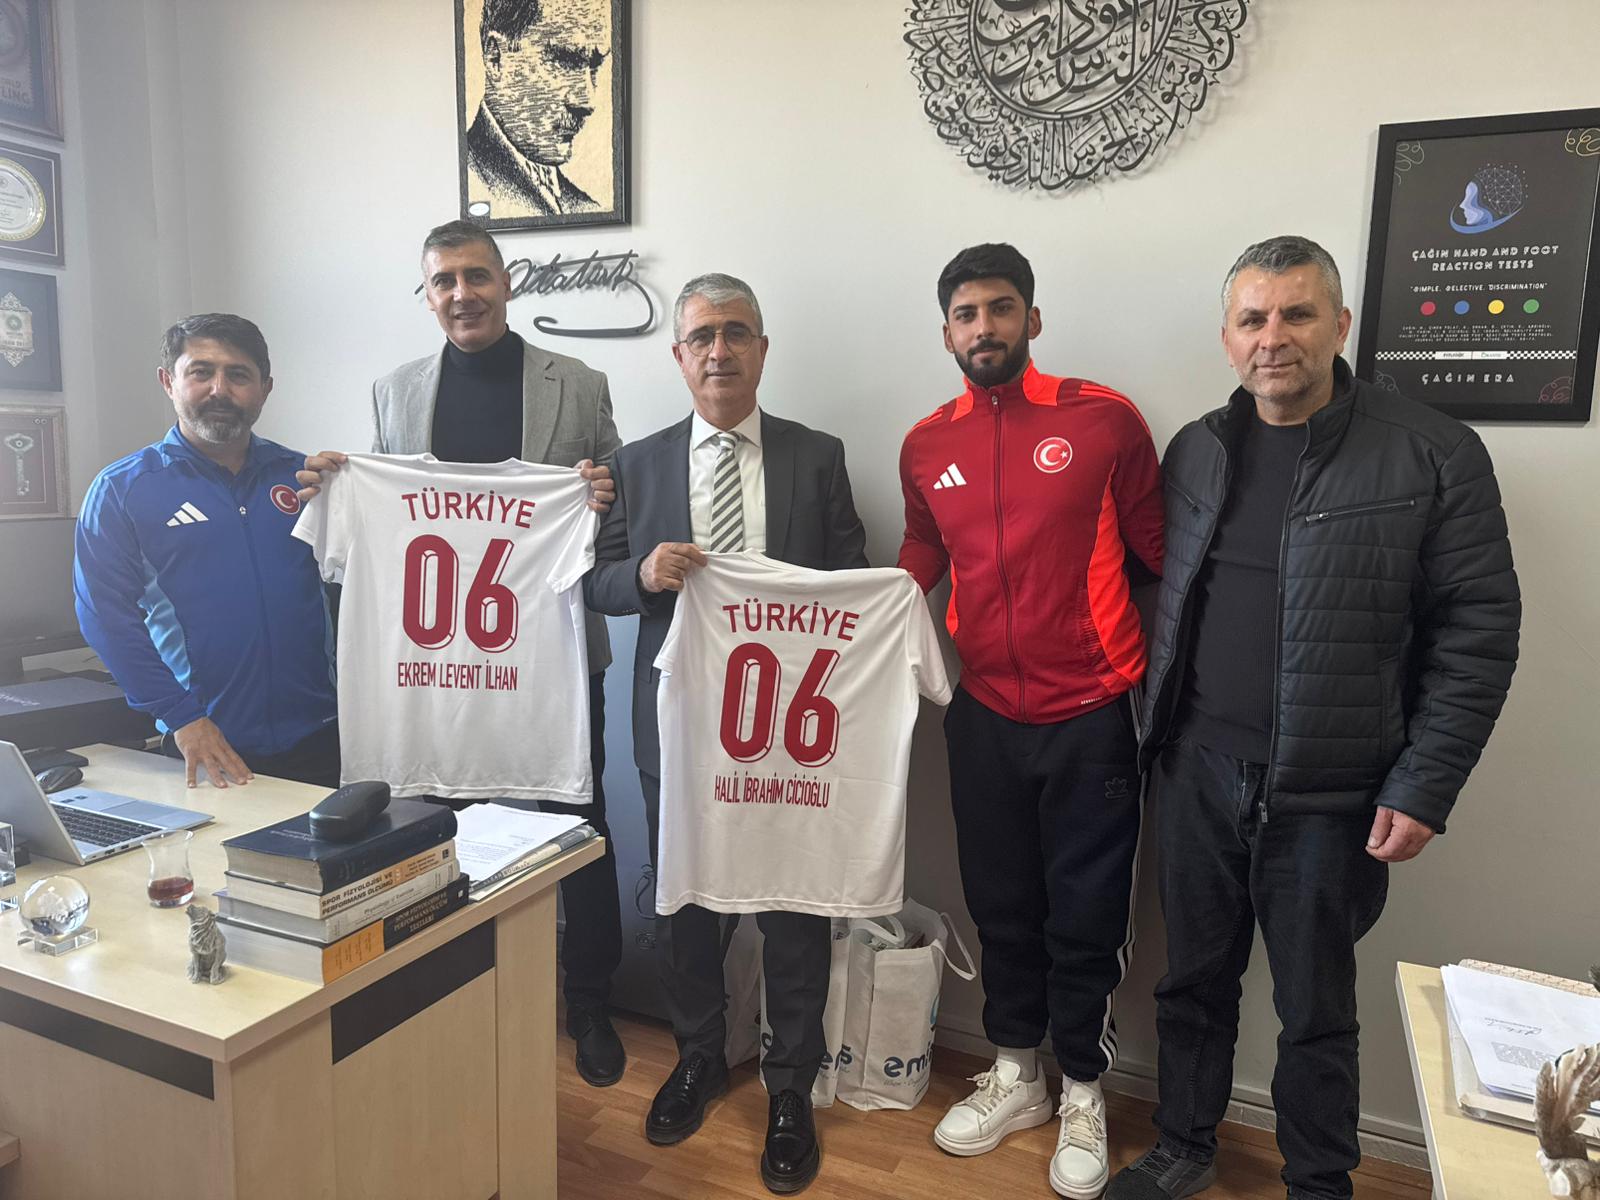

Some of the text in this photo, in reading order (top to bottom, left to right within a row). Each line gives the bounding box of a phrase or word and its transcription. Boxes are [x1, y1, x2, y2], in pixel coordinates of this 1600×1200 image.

[1432, 259, 1534, 272] REACTION TESTS
[1453, 248, 1488, 257] HAND
[1492, 247, 1519, 257] AND
[1523, 245, 1559, 255] FOOT
[1483, 373, 1514, 383] ERA
[401, 487, 536, 529] TÜRKİYE
[403, 534, 519, 653] 06
[722, 597, 860, 642] TÜRKİYE
[397, 659, 518, 691] EKREM LEVENT İLHAN
[719, 642, 840, 768] 06
[714, 771, 830, 808] HALİL İBRAHİM CİCİOĞLU
[321, 894, 341, 907] SPOR
[321, 891, 367, 916] PERFORMANS
